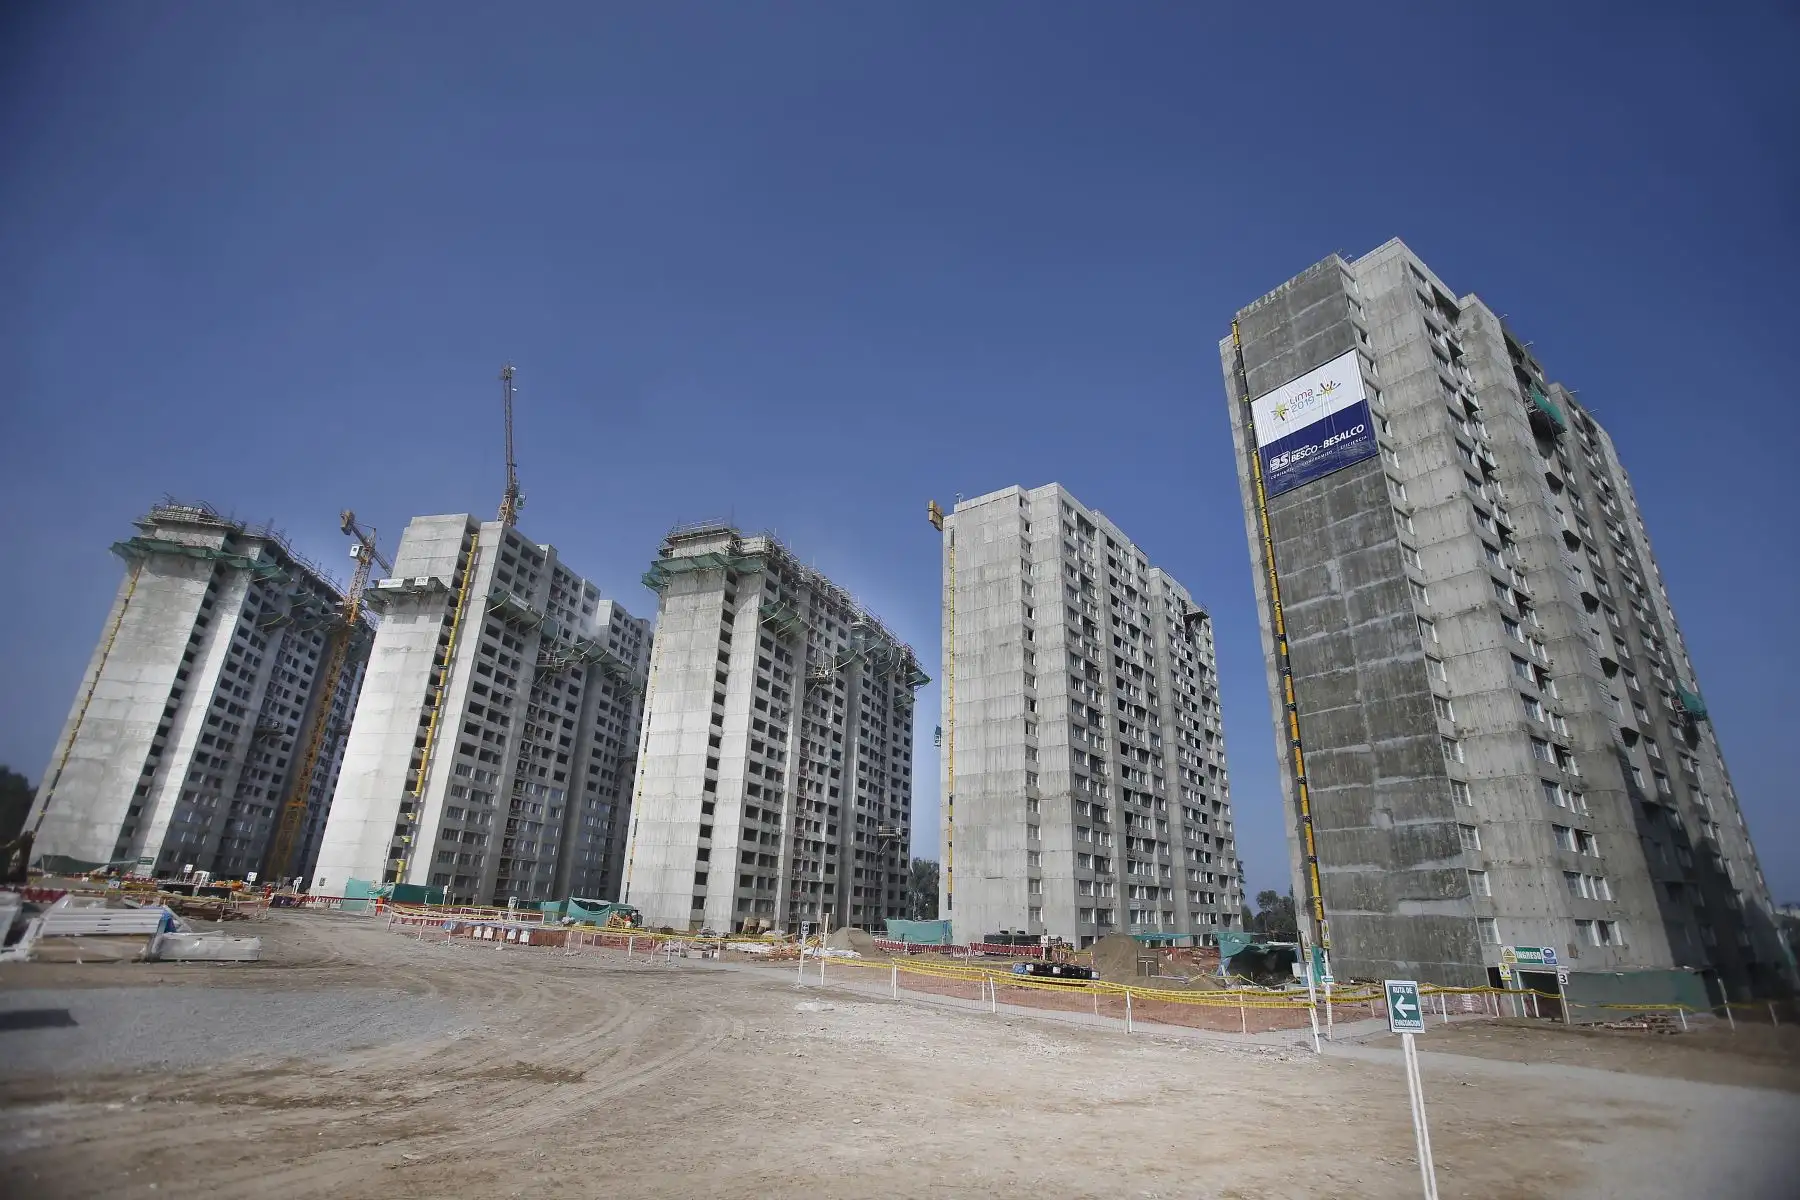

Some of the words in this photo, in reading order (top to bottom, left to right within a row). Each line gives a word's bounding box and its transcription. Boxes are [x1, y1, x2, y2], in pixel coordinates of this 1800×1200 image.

[1291, 396, 1315, 413] 2019
[1291, 445, 1318, 463] BESCO
[1323, 424, 1365, 449] BESALCO
[1516, 950, 1542, 960] INGRESO
[1558, 974, 1567, 984] 3
[1392, 986, 1406, 994] RUTA
[1405, 986, 1413, 994] DE
